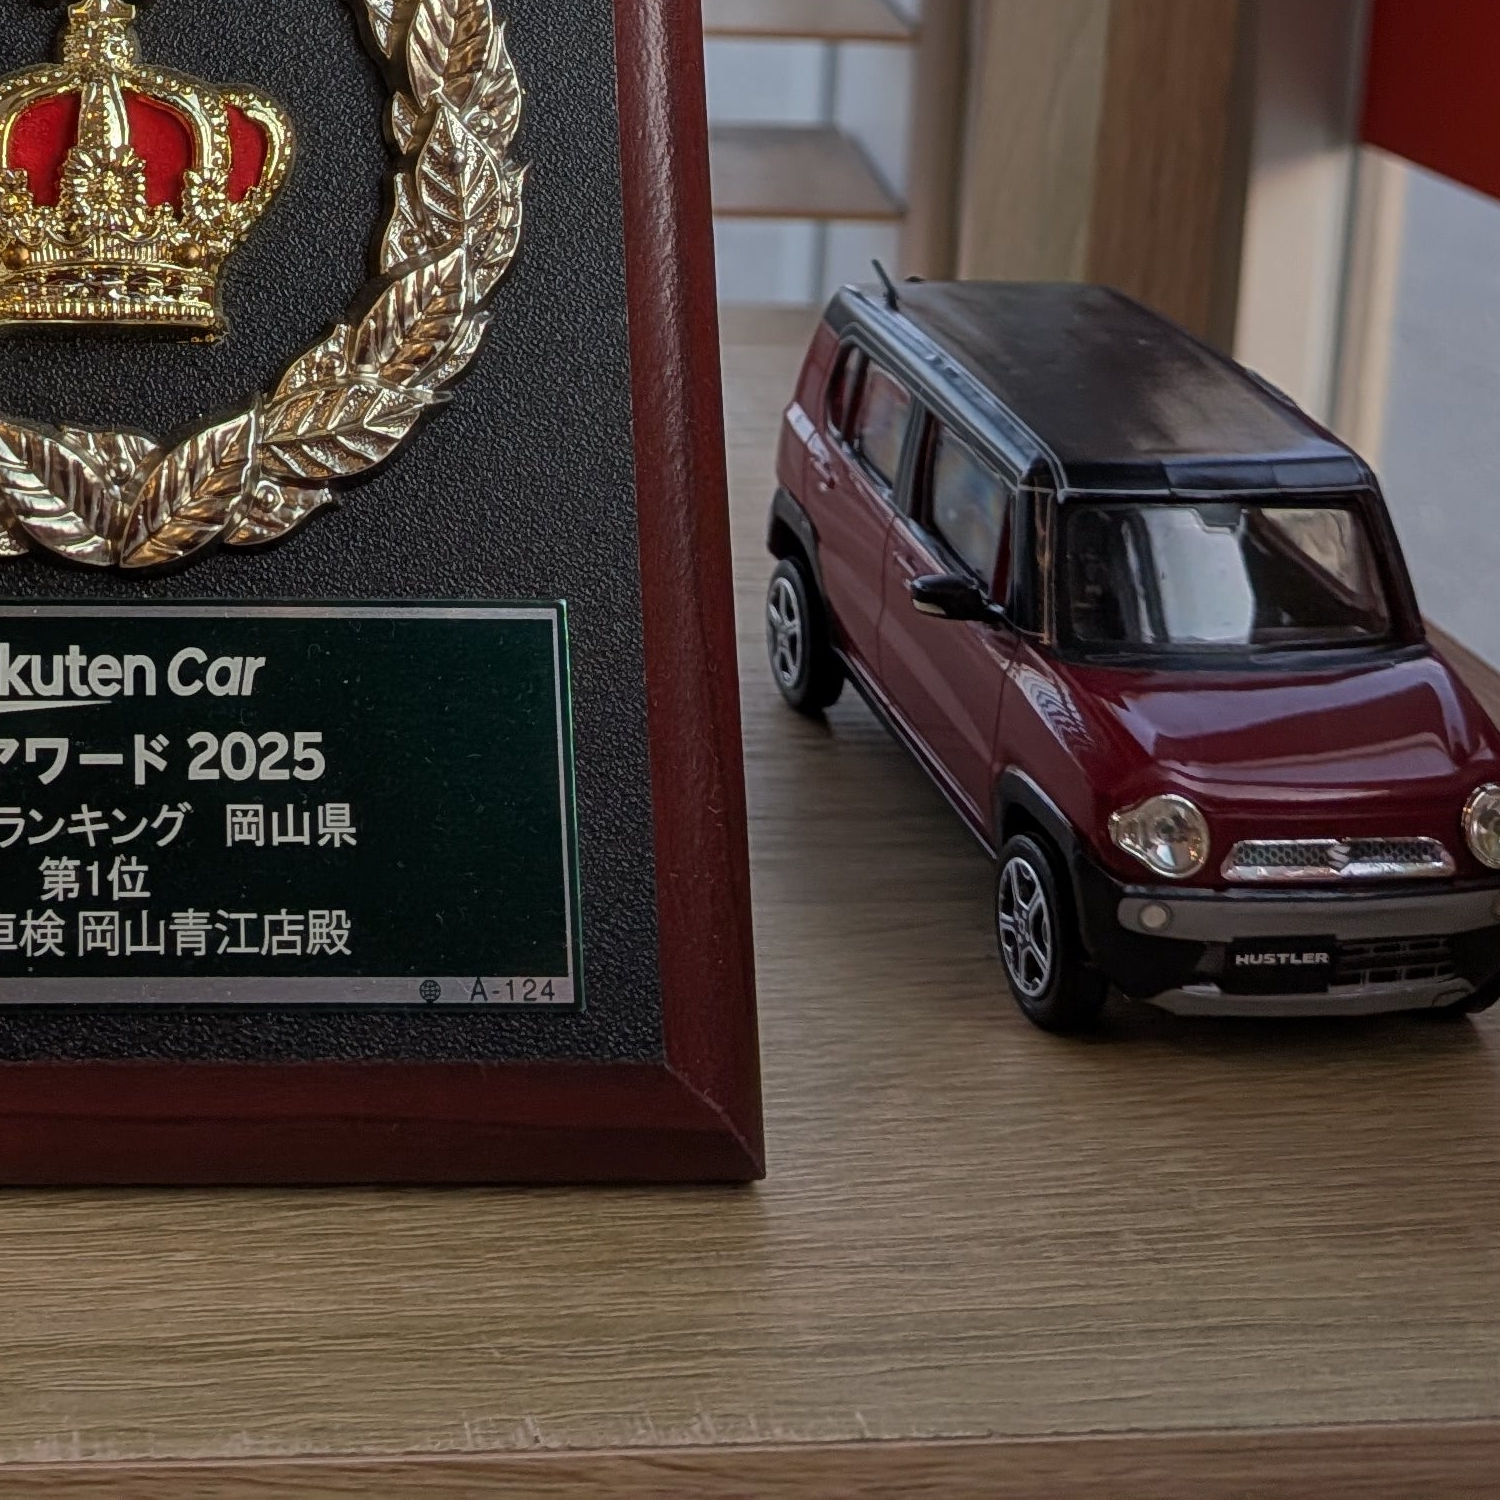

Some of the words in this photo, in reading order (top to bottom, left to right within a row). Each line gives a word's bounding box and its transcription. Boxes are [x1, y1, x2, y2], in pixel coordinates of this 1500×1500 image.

[167, 647, 267, 697] Car
[187, 731, 326, 781] 2025
[225, 802, 357, 848] 岡山県
[38, 854, 151, 902] 第1位
[78, 908, 352, 957] 岡山青江店殿
[1236, 952, 1329, 965] HUSTLER
[470, 976, 556, 1001] A-124
